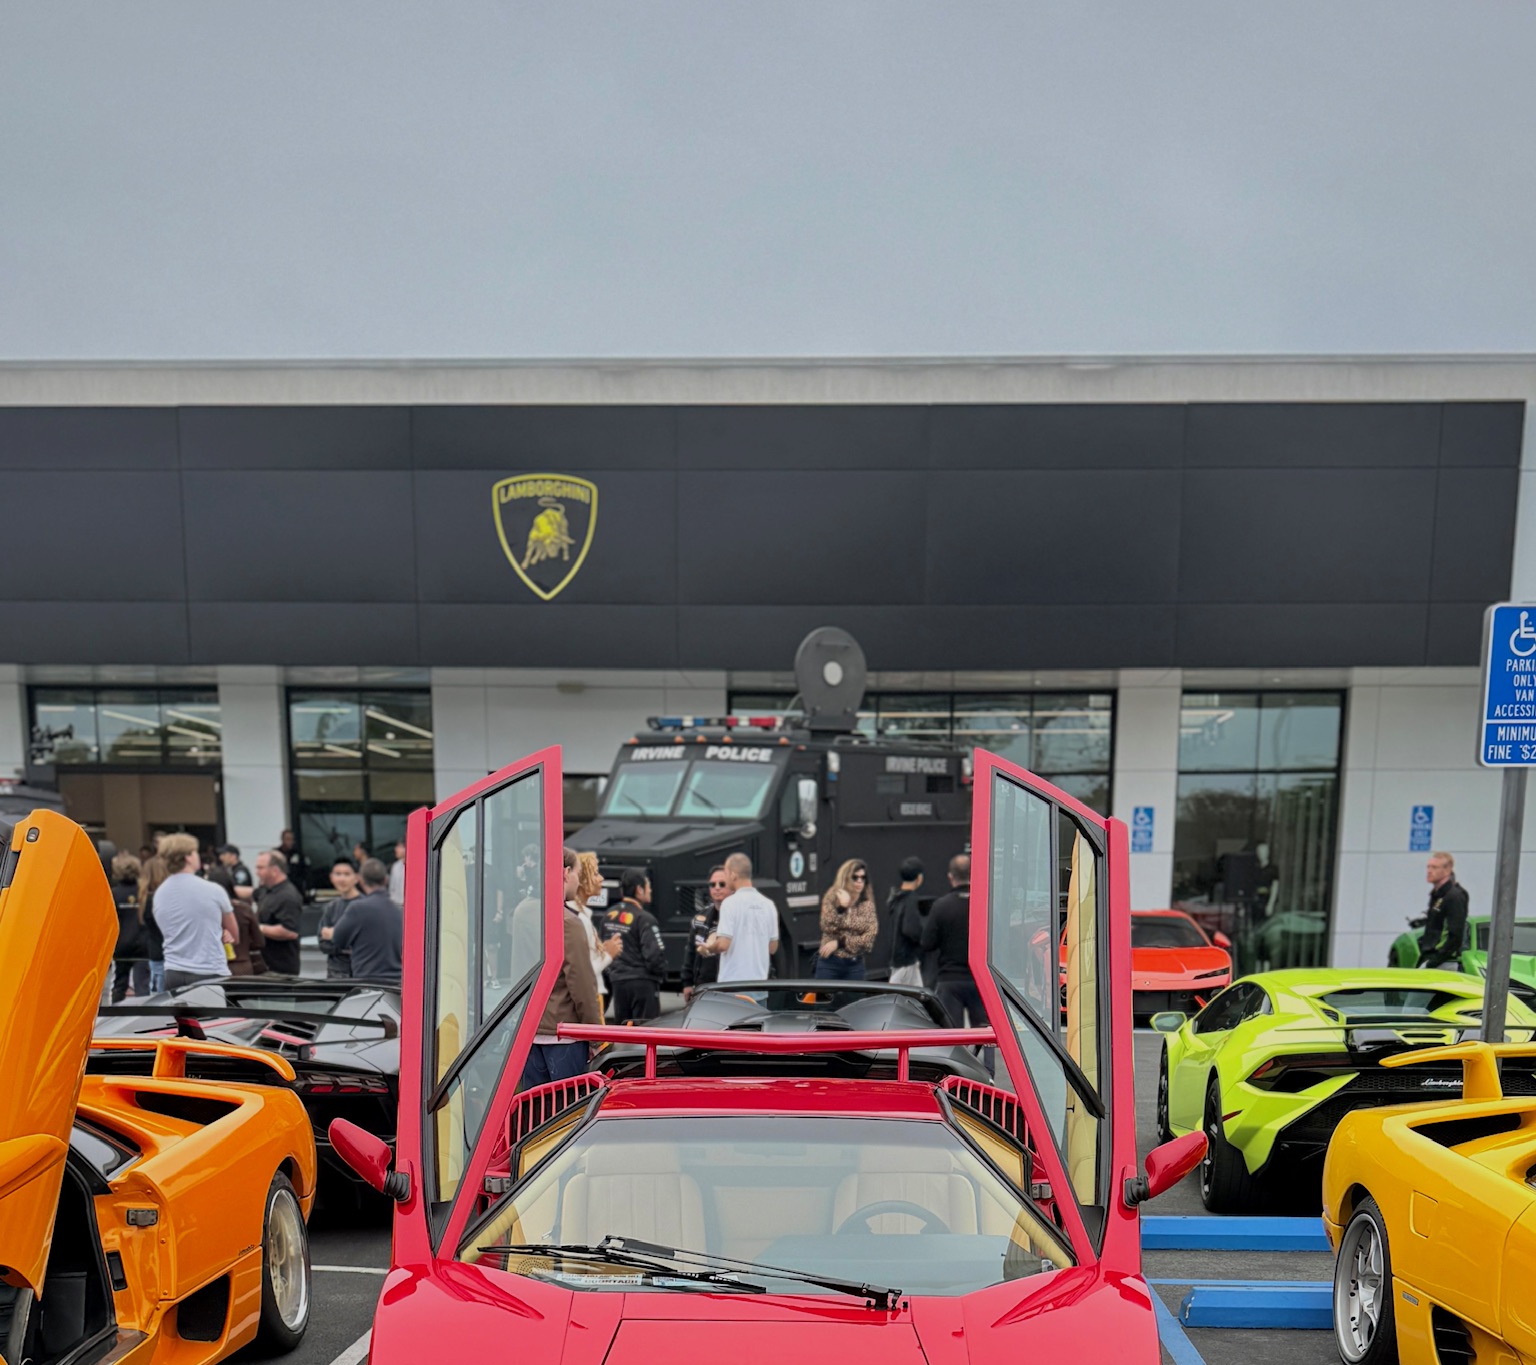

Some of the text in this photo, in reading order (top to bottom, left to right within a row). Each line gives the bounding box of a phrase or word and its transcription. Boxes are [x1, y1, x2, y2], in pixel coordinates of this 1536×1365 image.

[500, 480, 590, 504] LAMBORGHINI
[1506, 658, 1536, 672] PARKI
[1513, 674, 1536, 687] ONLY
[1515, 689, 1535, 702] VAN
[1494, 704, 1536, 717] ACCESSI
[1497, 726, 1536, 742] MINIMU
[631, 746, 773, 762] IRVINE POLICE
[1487, 744, 1536, 760] FINE $2
[886, 756, 947, 773] IRVINE POLICE
[786, 881, 807, 893] SWAT
[1421, 1078, 1463, 1088] Lamborghi
